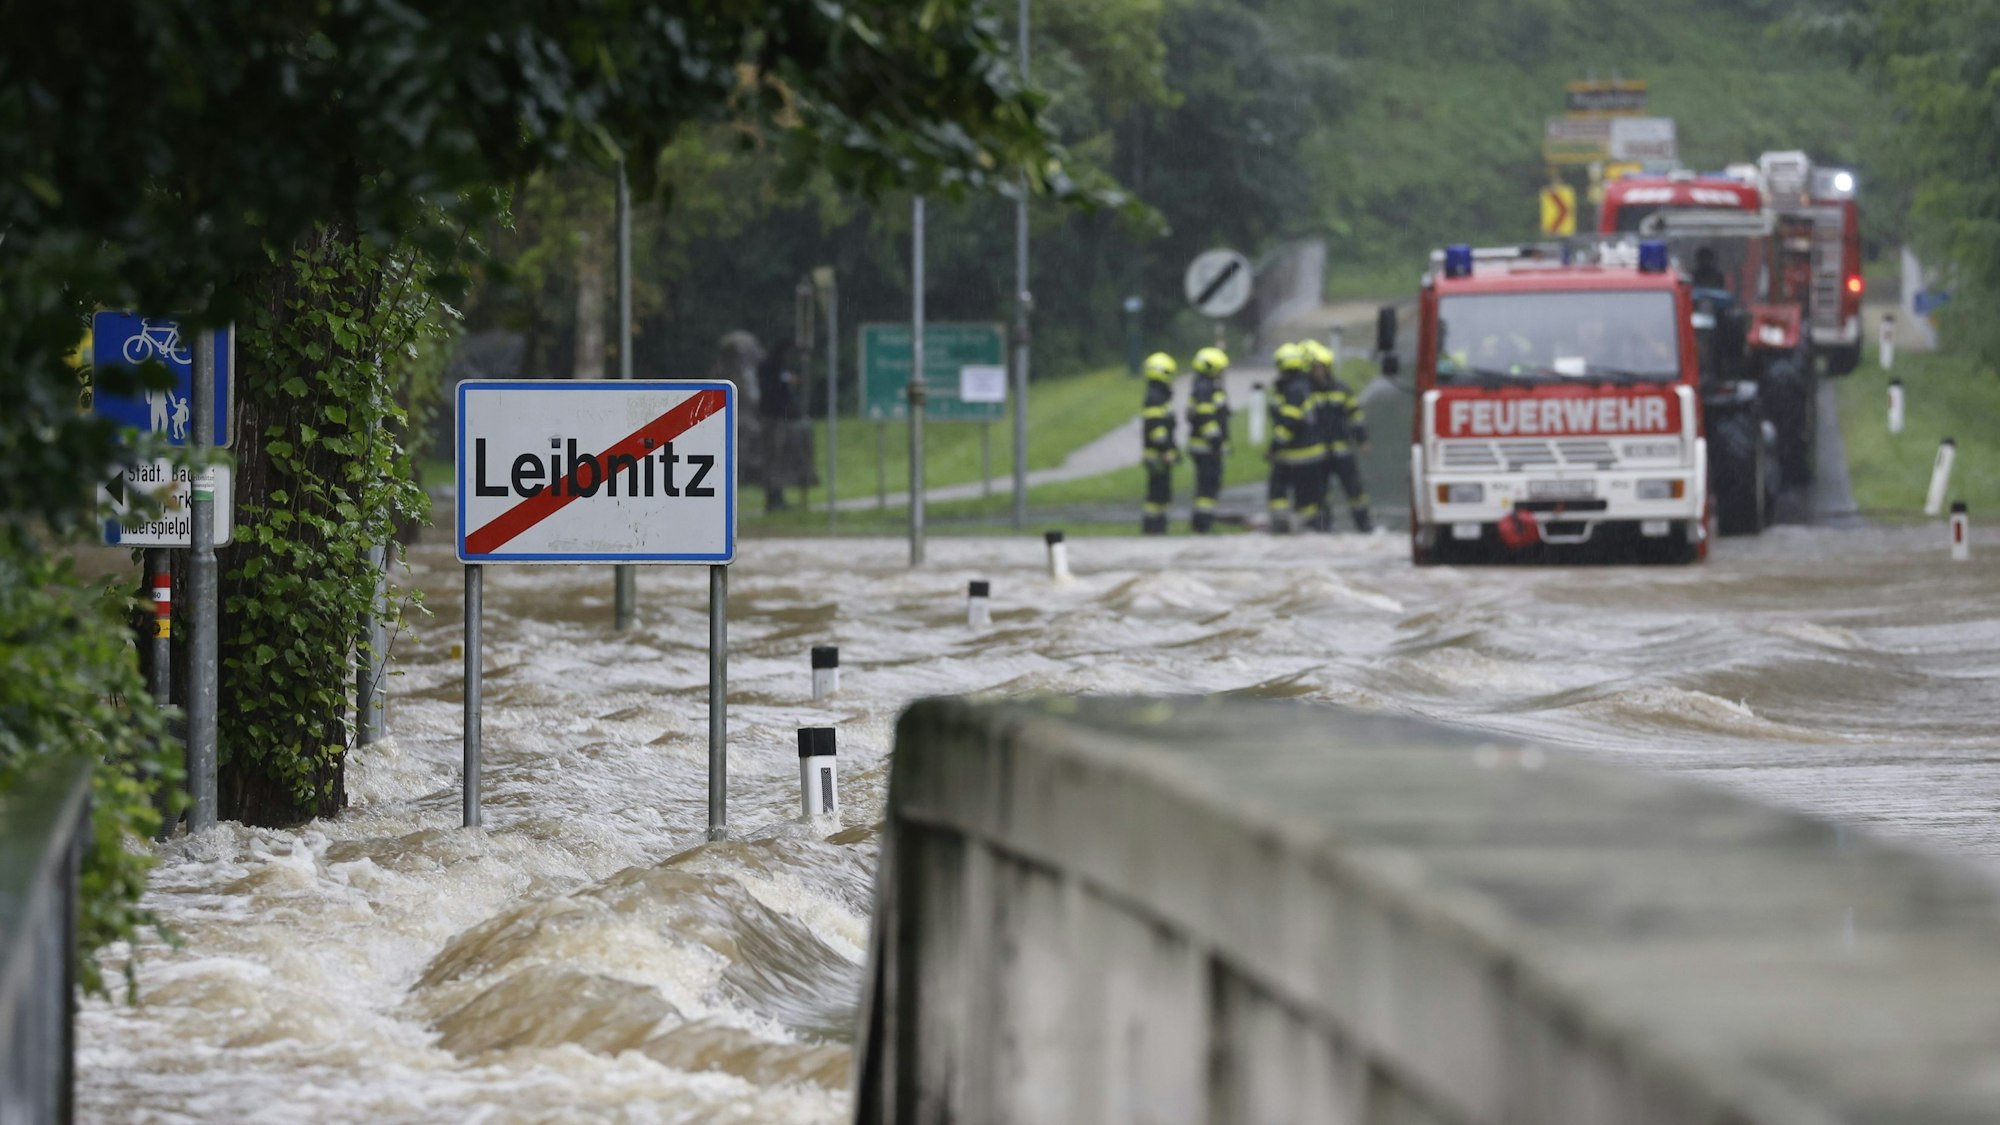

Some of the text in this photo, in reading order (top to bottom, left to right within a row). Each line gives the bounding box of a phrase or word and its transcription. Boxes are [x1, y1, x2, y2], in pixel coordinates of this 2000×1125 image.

[1450, 396, 1668, 435] FEUERWEHR
[128, 464, 165, 482] Städt.
[475, 438, 715, 498] Leibnitz
